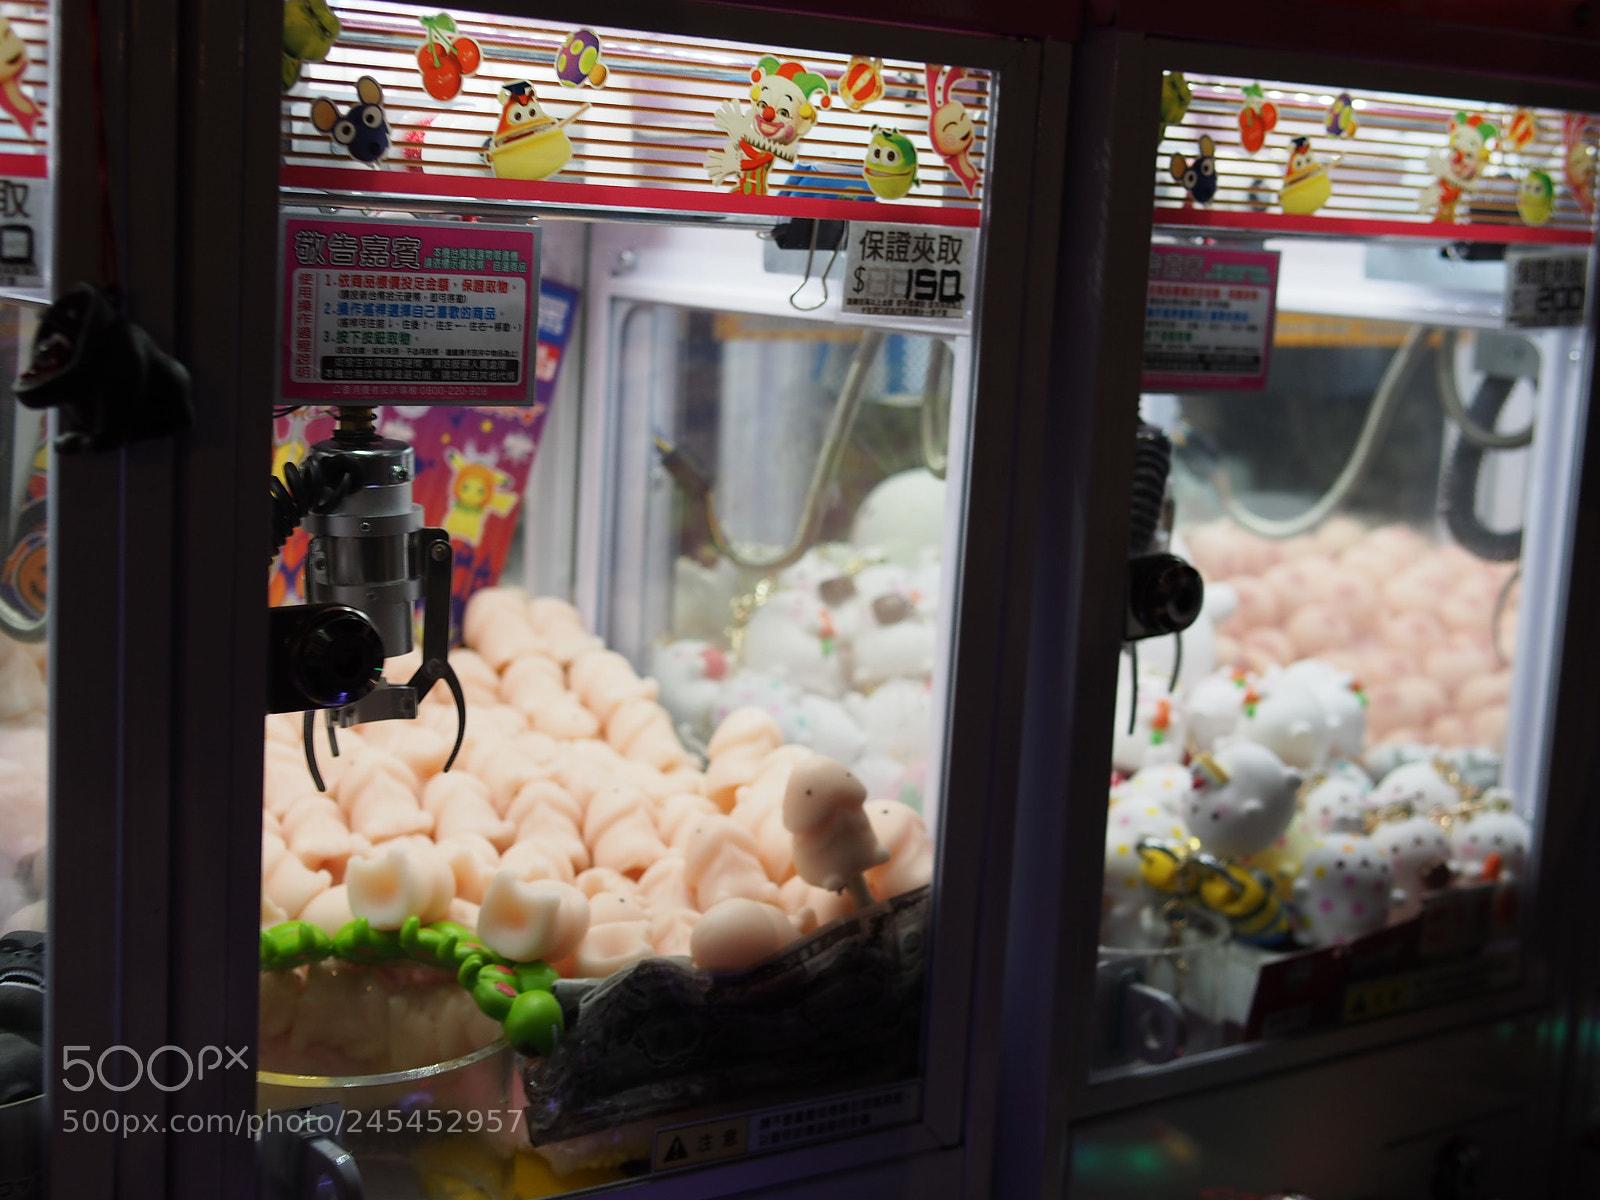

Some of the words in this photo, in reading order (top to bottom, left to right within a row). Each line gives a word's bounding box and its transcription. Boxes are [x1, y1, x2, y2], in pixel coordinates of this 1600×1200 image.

[294, 229, 422, 271] 敬告嘉賓
[859, 229, 964, 265] 保證夾取
